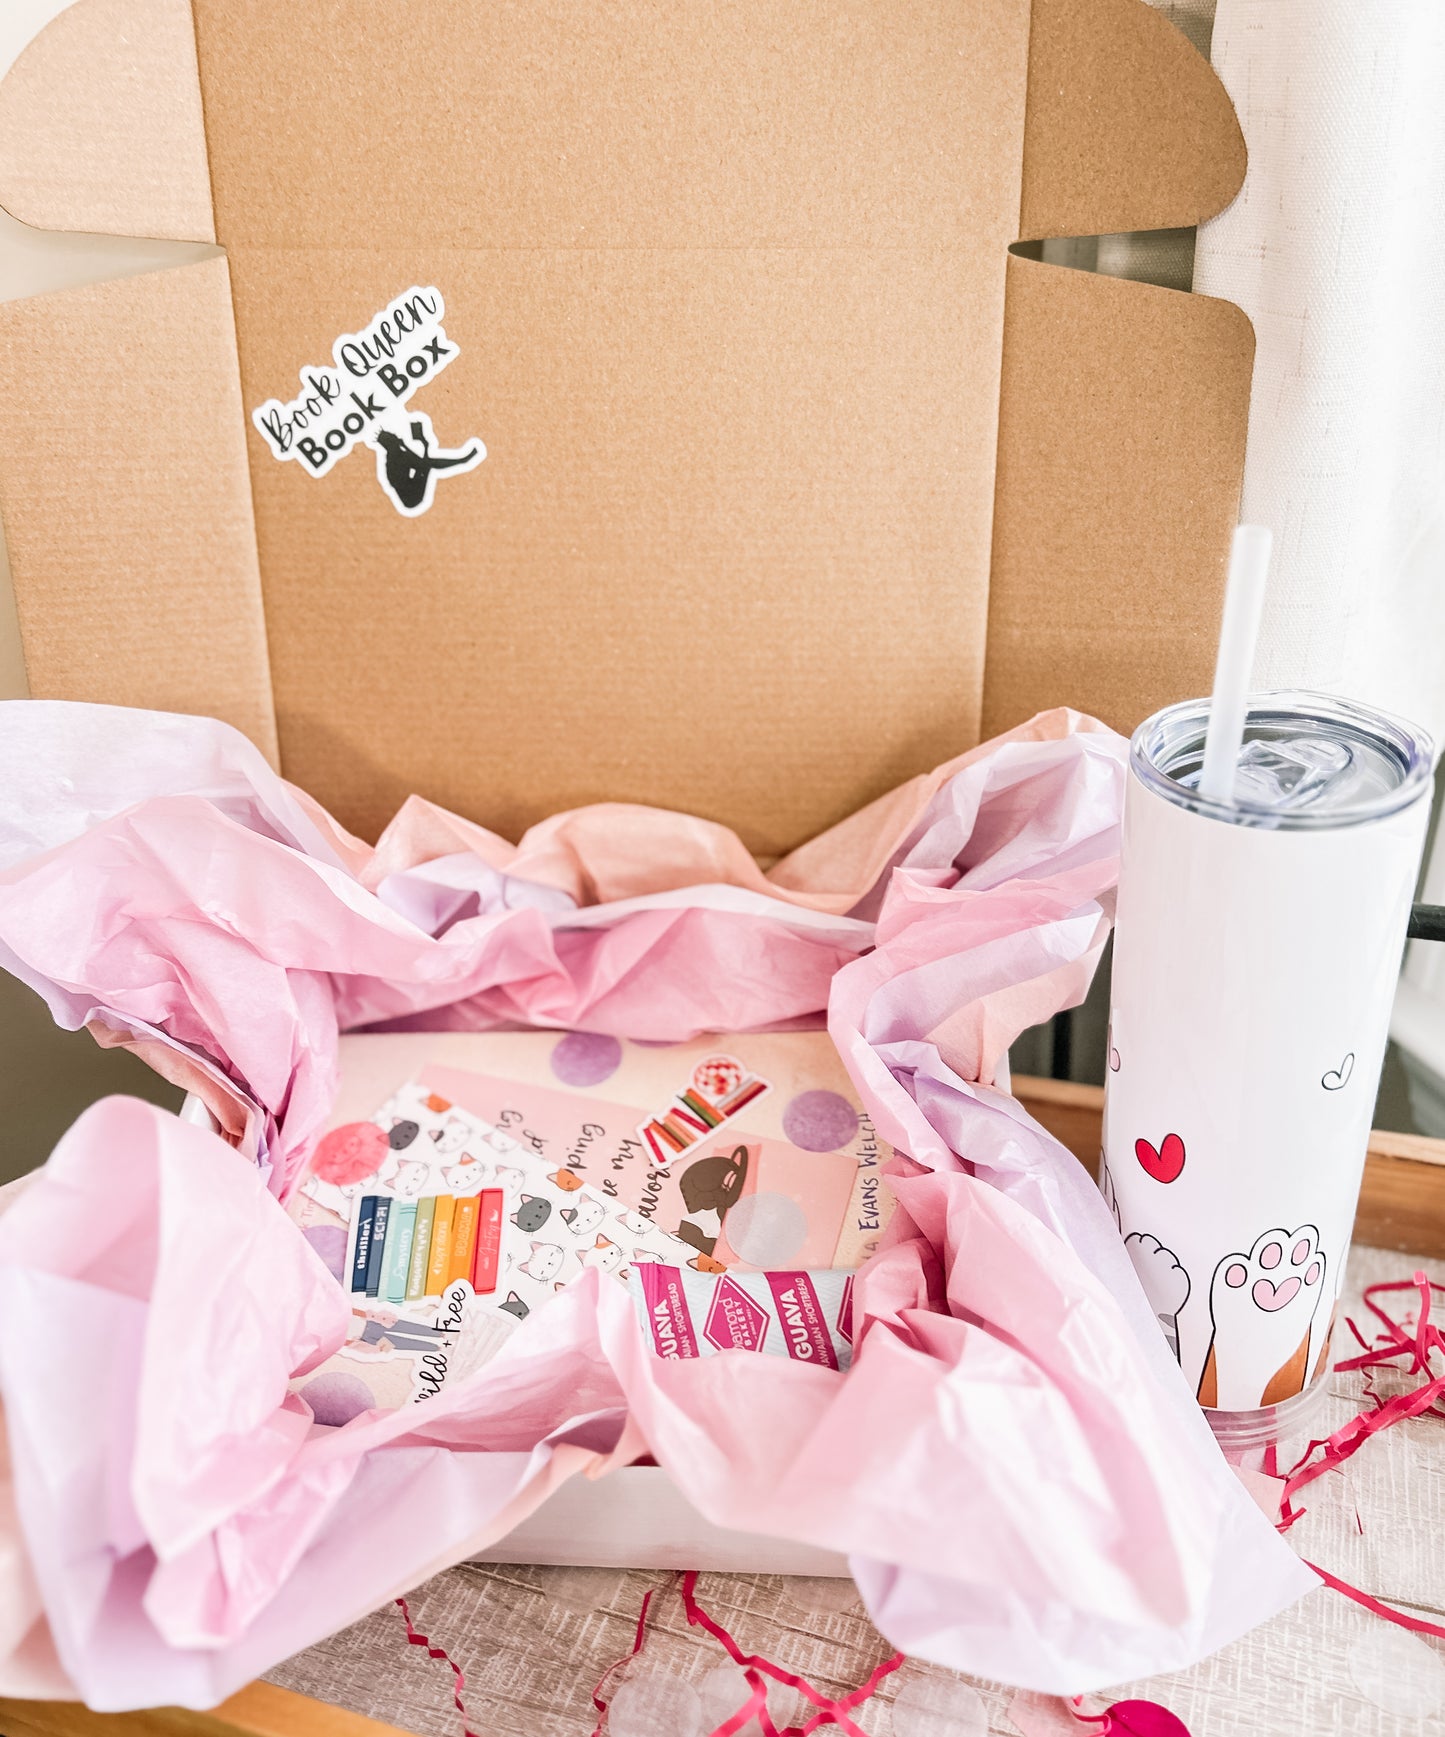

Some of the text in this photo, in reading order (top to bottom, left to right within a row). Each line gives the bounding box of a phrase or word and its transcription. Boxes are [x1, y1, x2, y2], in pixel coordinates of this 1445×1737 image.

[260, 294, 438, 453] Book Queen
[296, 335, 451, 470] Book Box
[563, 1123, 606, 1176] ping
[611, 1138, 642, 1171] my
[373, 1206, 388, 1241] SCI-FI
[858, 1177, 880, 1231] EVANS
[356, 1221, 371, 1270] thriller
[432, 1287, 467, 1333] Free
[667, 1282, 688, 1334] SHORTBREAD
[733, 1300, 753, 1347] BAKERY
[779, 1288, 814, 1360] GUAVA
[794, 1277, 819, 1325] SHORTBREAD
